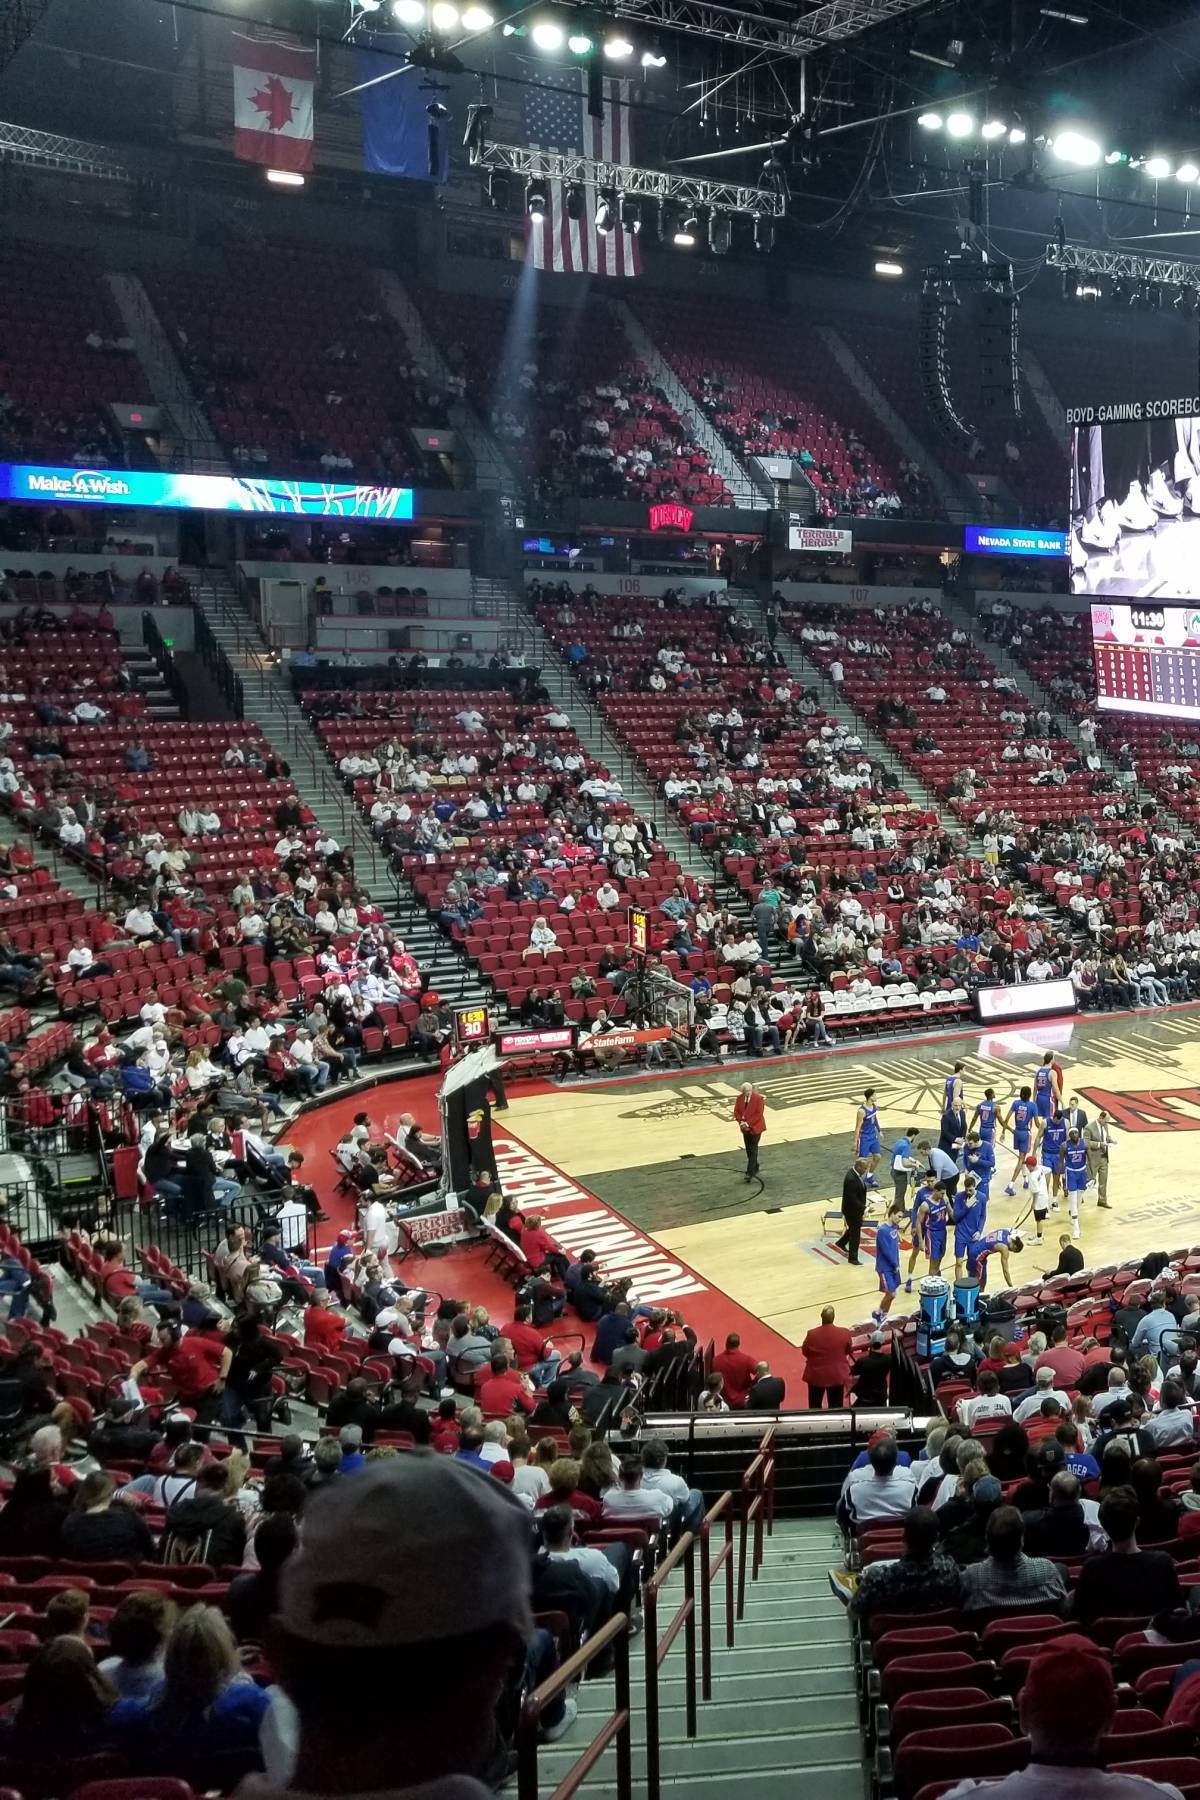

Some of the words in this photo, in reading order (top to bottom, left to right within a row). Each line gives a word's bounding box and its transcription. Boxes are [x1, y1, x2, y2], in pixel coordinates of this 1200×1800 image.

[1066, 408, 1094, 423] BOYD
[1098, 402, 1142, 421] GAMING
[796, 529, 844, 539] TERRIBLE
[801, 538, 839, 548] HERBST
[978, 536, 1010, 546] NEVADA
[1012, 538, 1035, 548] STATE
[1038, 540, 1061, 549] BANK
[618, 579, 640, 593] 106
[850, 589, 868, 602] 107
[1132, 612, 1163, 626] 11:30
[464, 1022, 481, 1035] 30
